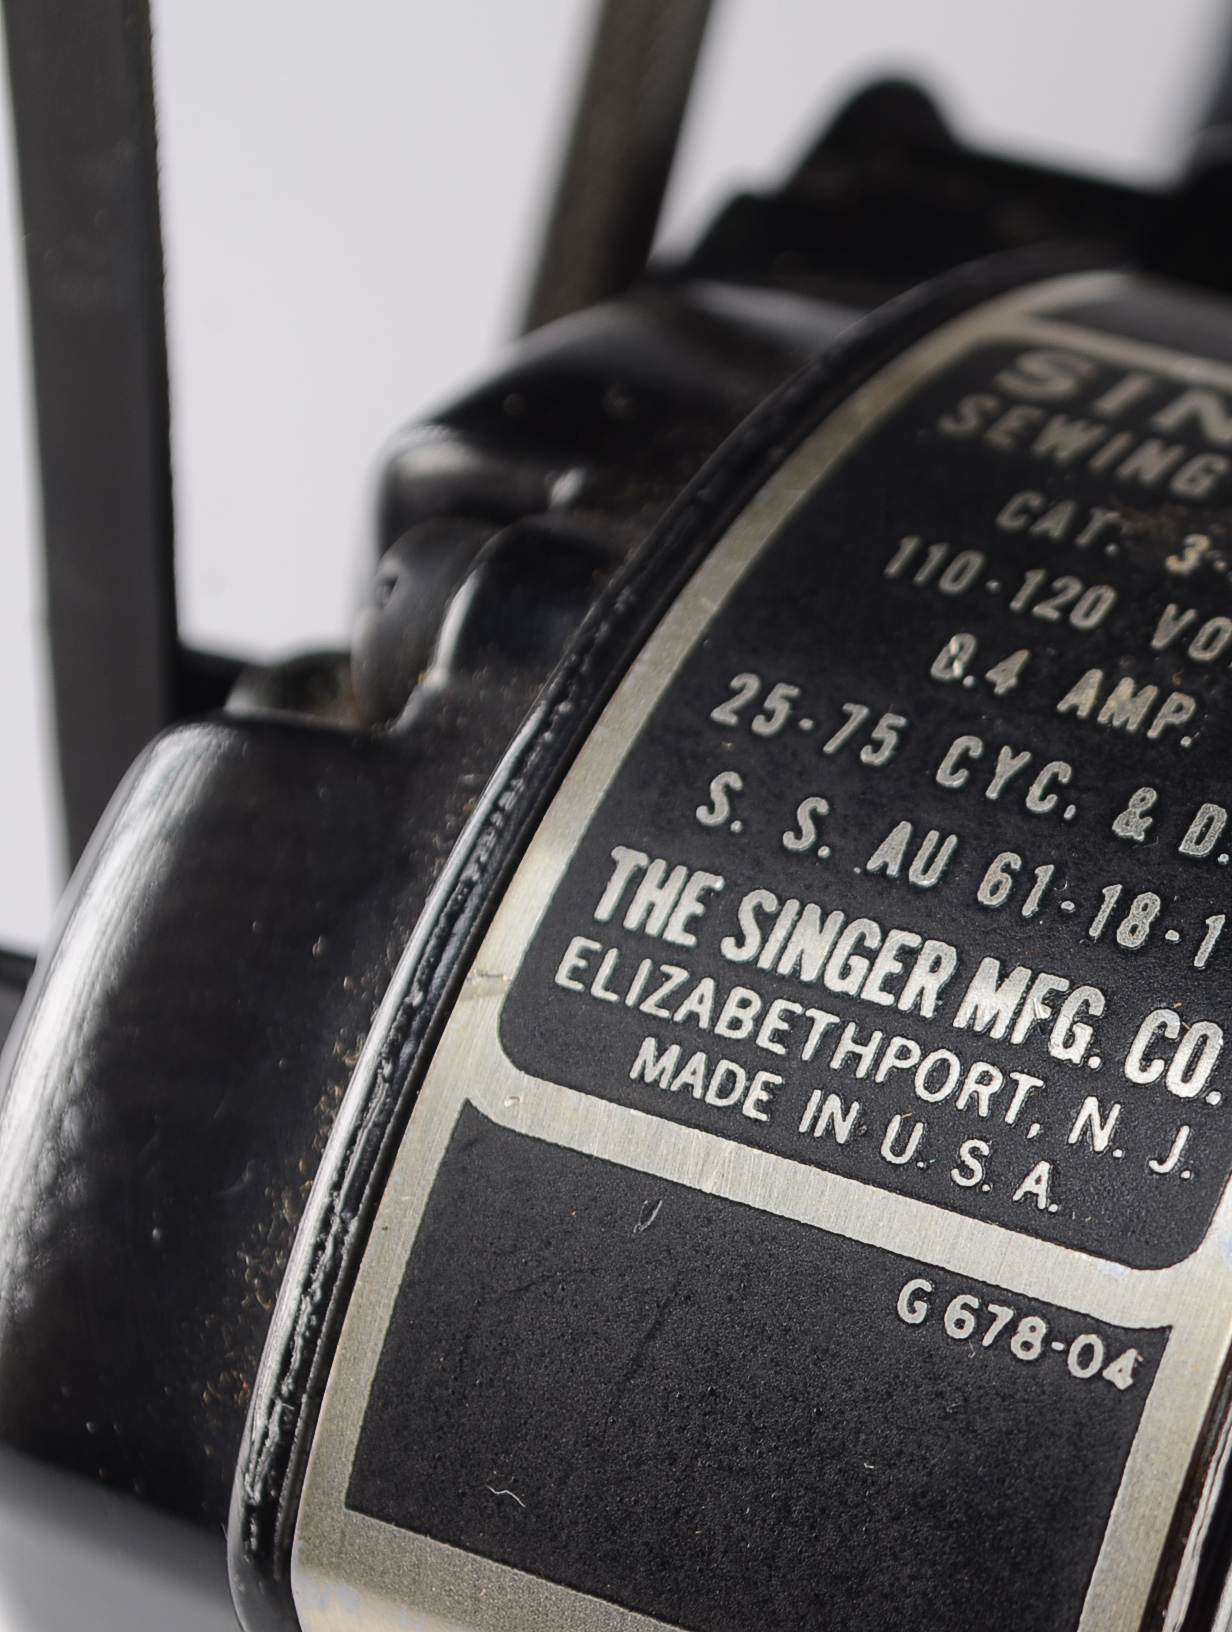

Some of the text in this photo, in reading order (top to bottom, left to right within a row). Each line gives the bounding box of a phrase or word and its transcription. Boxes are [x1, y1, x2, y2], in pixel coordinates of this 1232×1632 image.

[940, 394, 1230, 495] SEWING
[885, 536, 1117, 630] 110-120
[996, 492, 1120, 556] CAT.
[711, 673, 906, 766] 25-75
[936, 735, 1076, 820] CYC.
[1112, 787, 1157, 843] &
[1179, 803, 1230, 863] D.
[1057, 668, 1197, 747] AMP.
[696, 771, 1225, 968] S. S. AU 61-18-1
[594, 845, 1224, 1106] THE SINGER MFG. CO.
[555, 936, 1192, 1178] ELIZABETHPORT, N. J.
[630, 1037, 1058, 1212] MADE IN U. S. A.
[897, 1279, 1142, 1390] G 678-04
